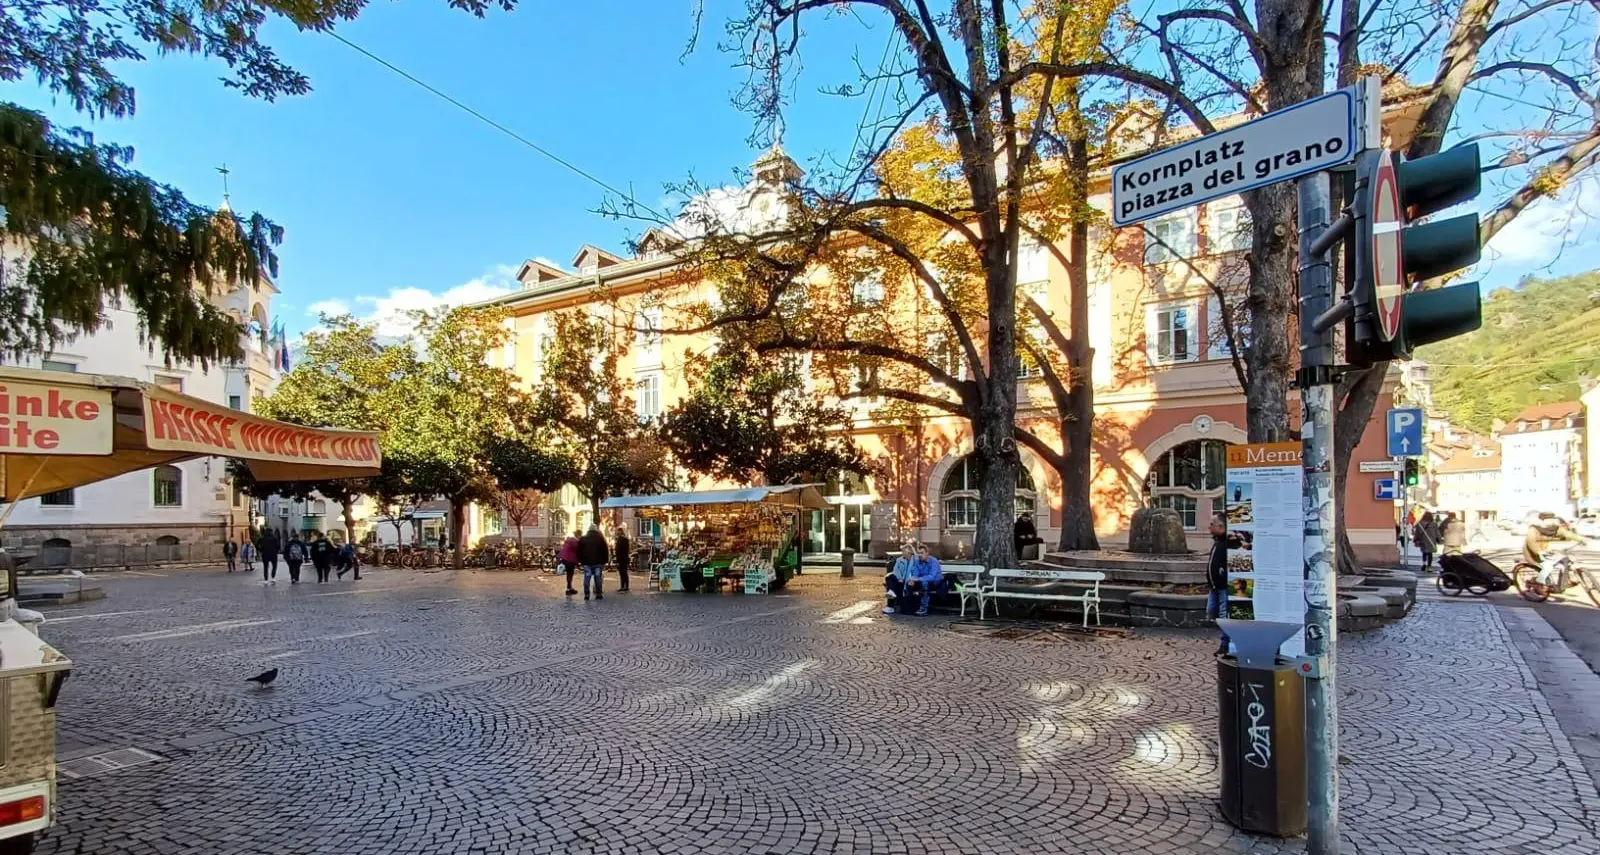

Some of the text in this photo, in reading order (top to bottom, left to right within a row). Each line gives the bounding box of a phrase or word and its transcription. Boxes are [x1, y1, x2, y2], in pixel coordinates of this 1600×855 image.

[1121, 139, 1245, 192] Kornplatz
[1121, 137, 1343, 218] piazza del grano
[150, 399, 238, 450] HEISSE
[330, 436, 379, 463] CALDI
[1394, 412, 1416, 433] P
